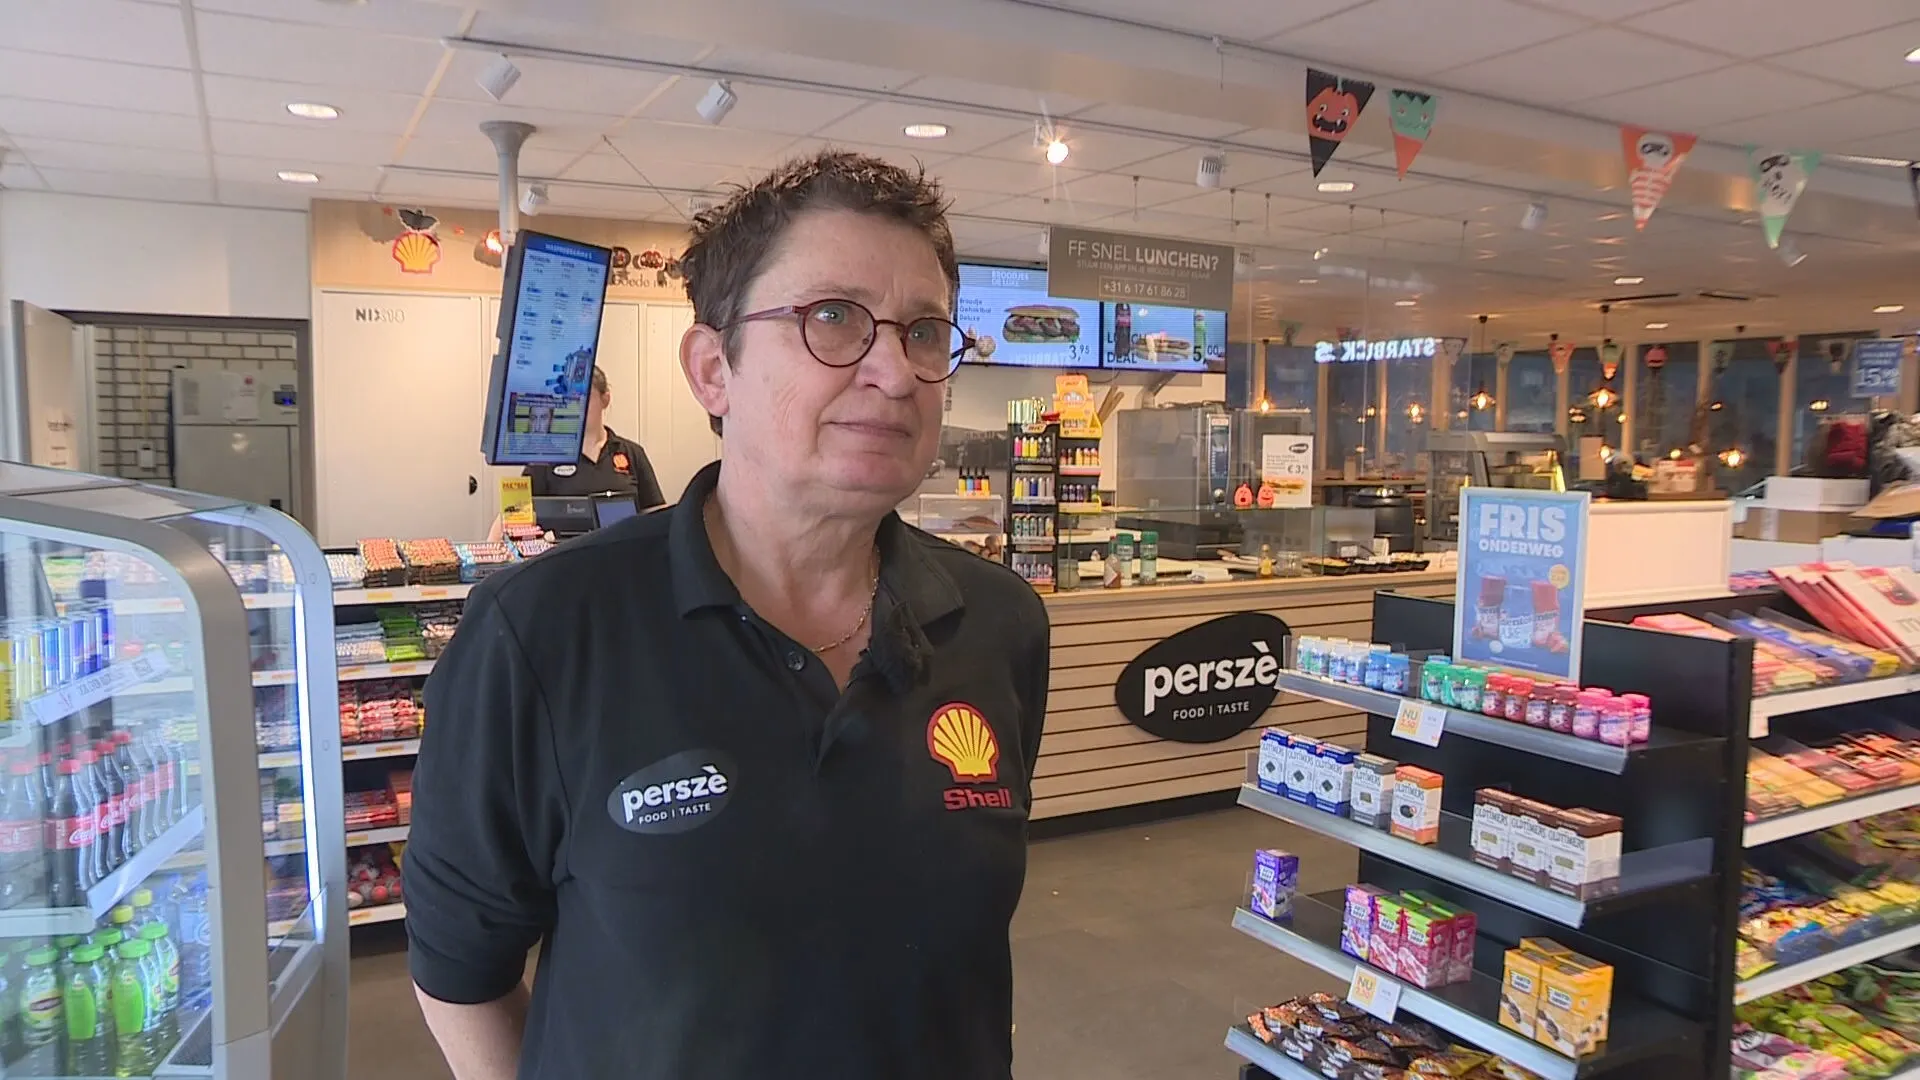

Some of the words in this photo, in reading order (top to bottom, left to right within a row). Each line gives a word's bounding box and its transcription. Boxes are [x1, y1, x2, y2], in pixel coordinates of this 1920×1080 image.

[1068, 240, 1087, 257] FF
[1091, 241, 1131, 262] SNEL
[1135, 247, 1219, 271] LUNCHEN?
[1103, 280, 1122, 293] +31
[1124, 282, 1131, 294] 6
[1134, 282, 1144, 295] 17
[1146, 283, 1158, 296] 61
[1160, 285, 1172, 297] 86
[1107, 351, 1138, 364] DEAL
[1478, 503, 1567, 542] FRIS
[1478, 539, 1565, 558] ONDERWEG
[1144, 640, 1279, 717] perszè
[1172, 707, 1205, 720] FOOD
[1217, 701, 1250, 715] TASTE
[1402, 708, 1418, 720] NU
[621, 764, 729, 824] perszè
[943, 787, 1013, 811] Shell
[638, 810, 668, 825] FOOD
[679, 802, 712, 817] TASTE
[1357, 975, 1374, 990] NU
